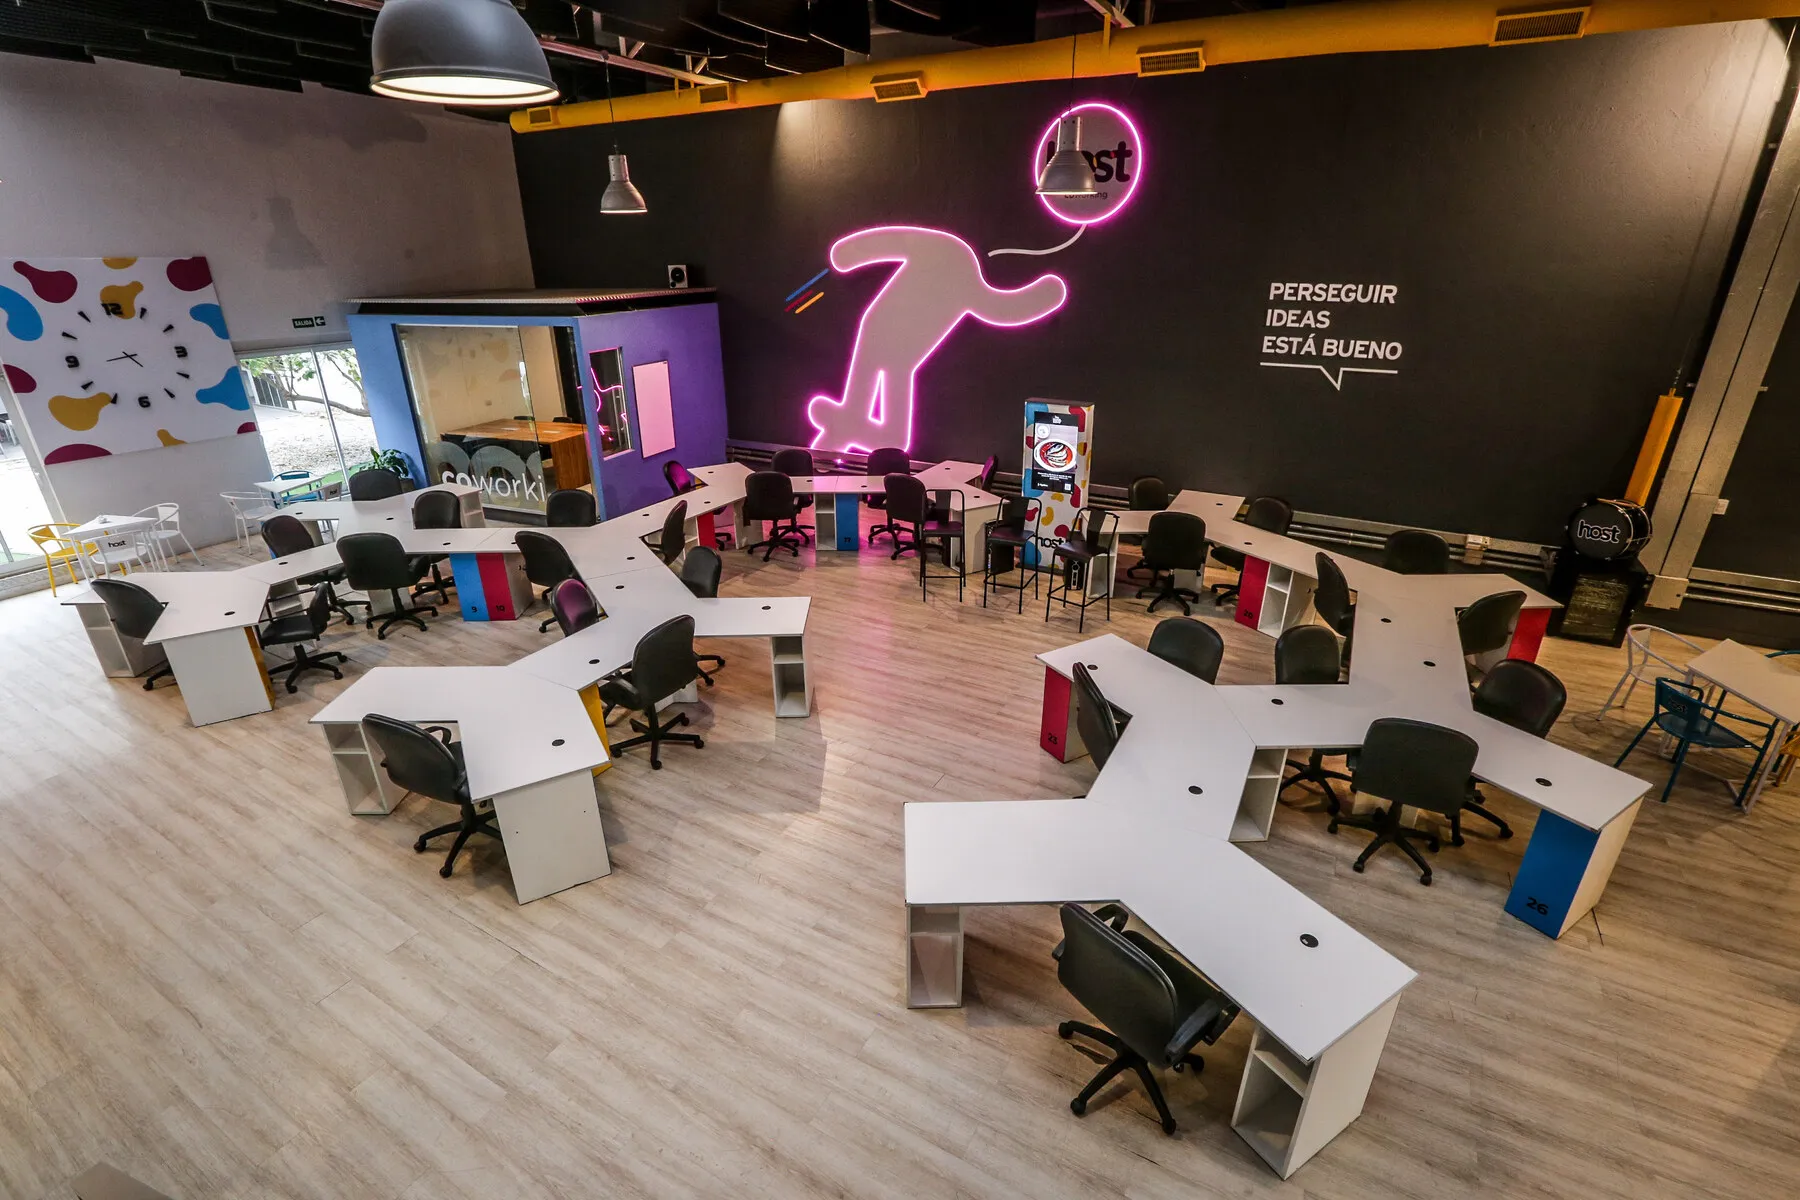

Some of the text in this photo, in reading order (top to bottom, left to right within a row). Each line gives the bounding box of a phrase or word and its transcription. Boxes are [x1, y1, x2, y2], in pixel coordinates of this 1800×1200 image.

[1047, 141, 1133, 183] st
[1269, 282, 1398, 304] PERSEGUIR
[101, 302, 123, 316] 12
[1265, 309, 1331, 329] IDEAS
[174, 345, 188, 358] 3
[1262, 333, 1403, 361] ESTÁ BUENO
[65, 355, 80, 368] 9
[137, 396, 151, 408] 6
[1577, 519, 1621, 544] host
[107, 540, 127, 548] host
[1526, 896, 1549, 916] 26
